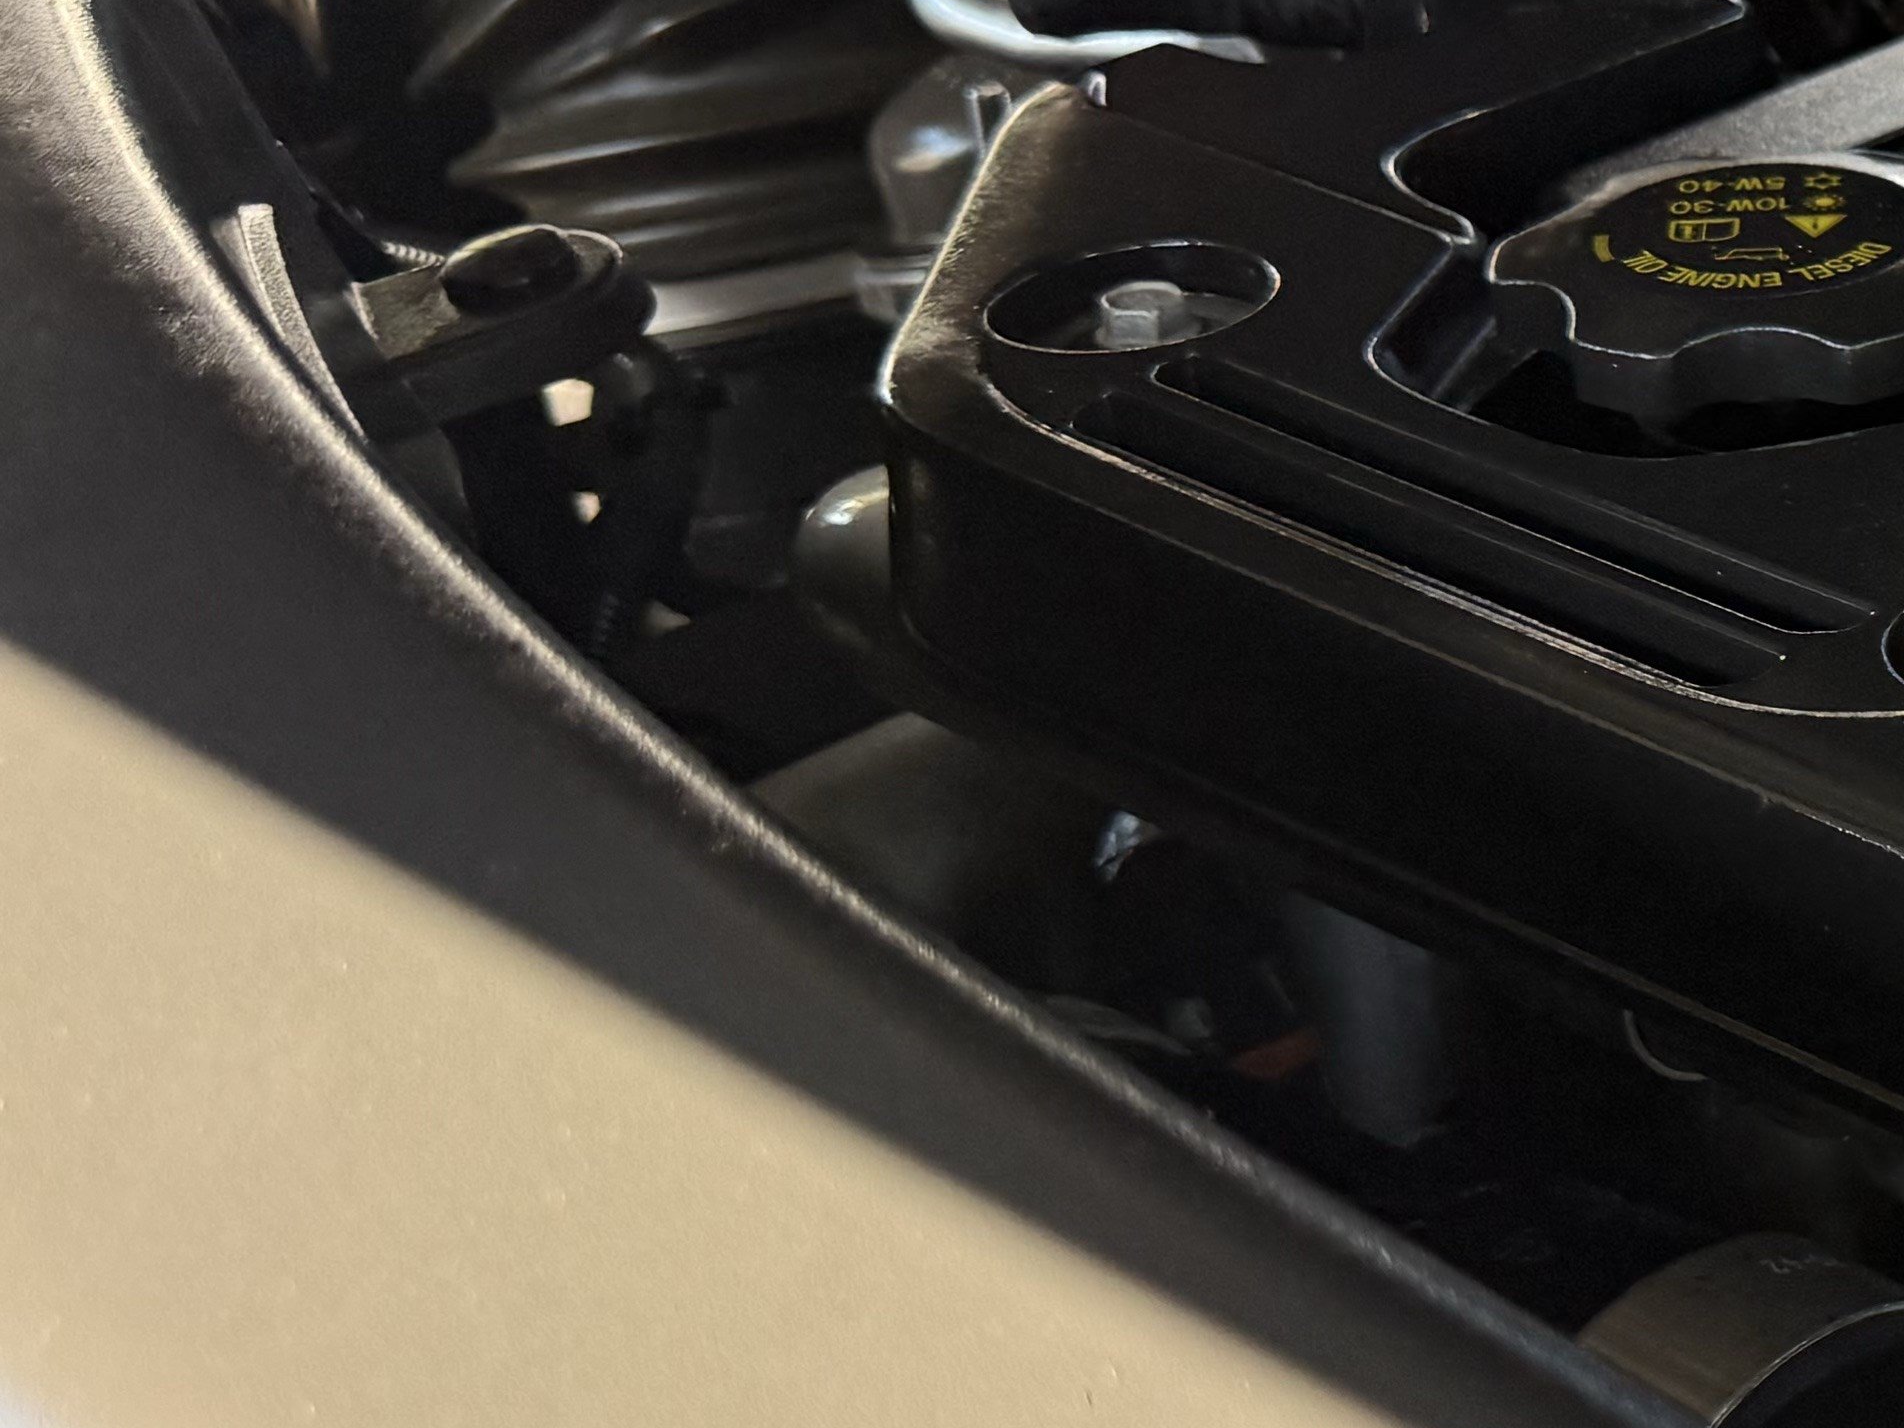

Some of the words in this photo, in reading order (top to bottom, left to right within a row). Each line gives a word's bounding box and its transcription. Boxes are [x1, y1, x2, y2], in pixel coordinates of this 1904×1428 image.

[1677, 175, 1787, 194] 5W-40
[1669, 196, 1790, 215] 10W-30
[1622, 248, 1669, 275] OIL
[1787, 241, 1893, 282] DIESEL
[1657, 267, 1783, 290] ENGINE
